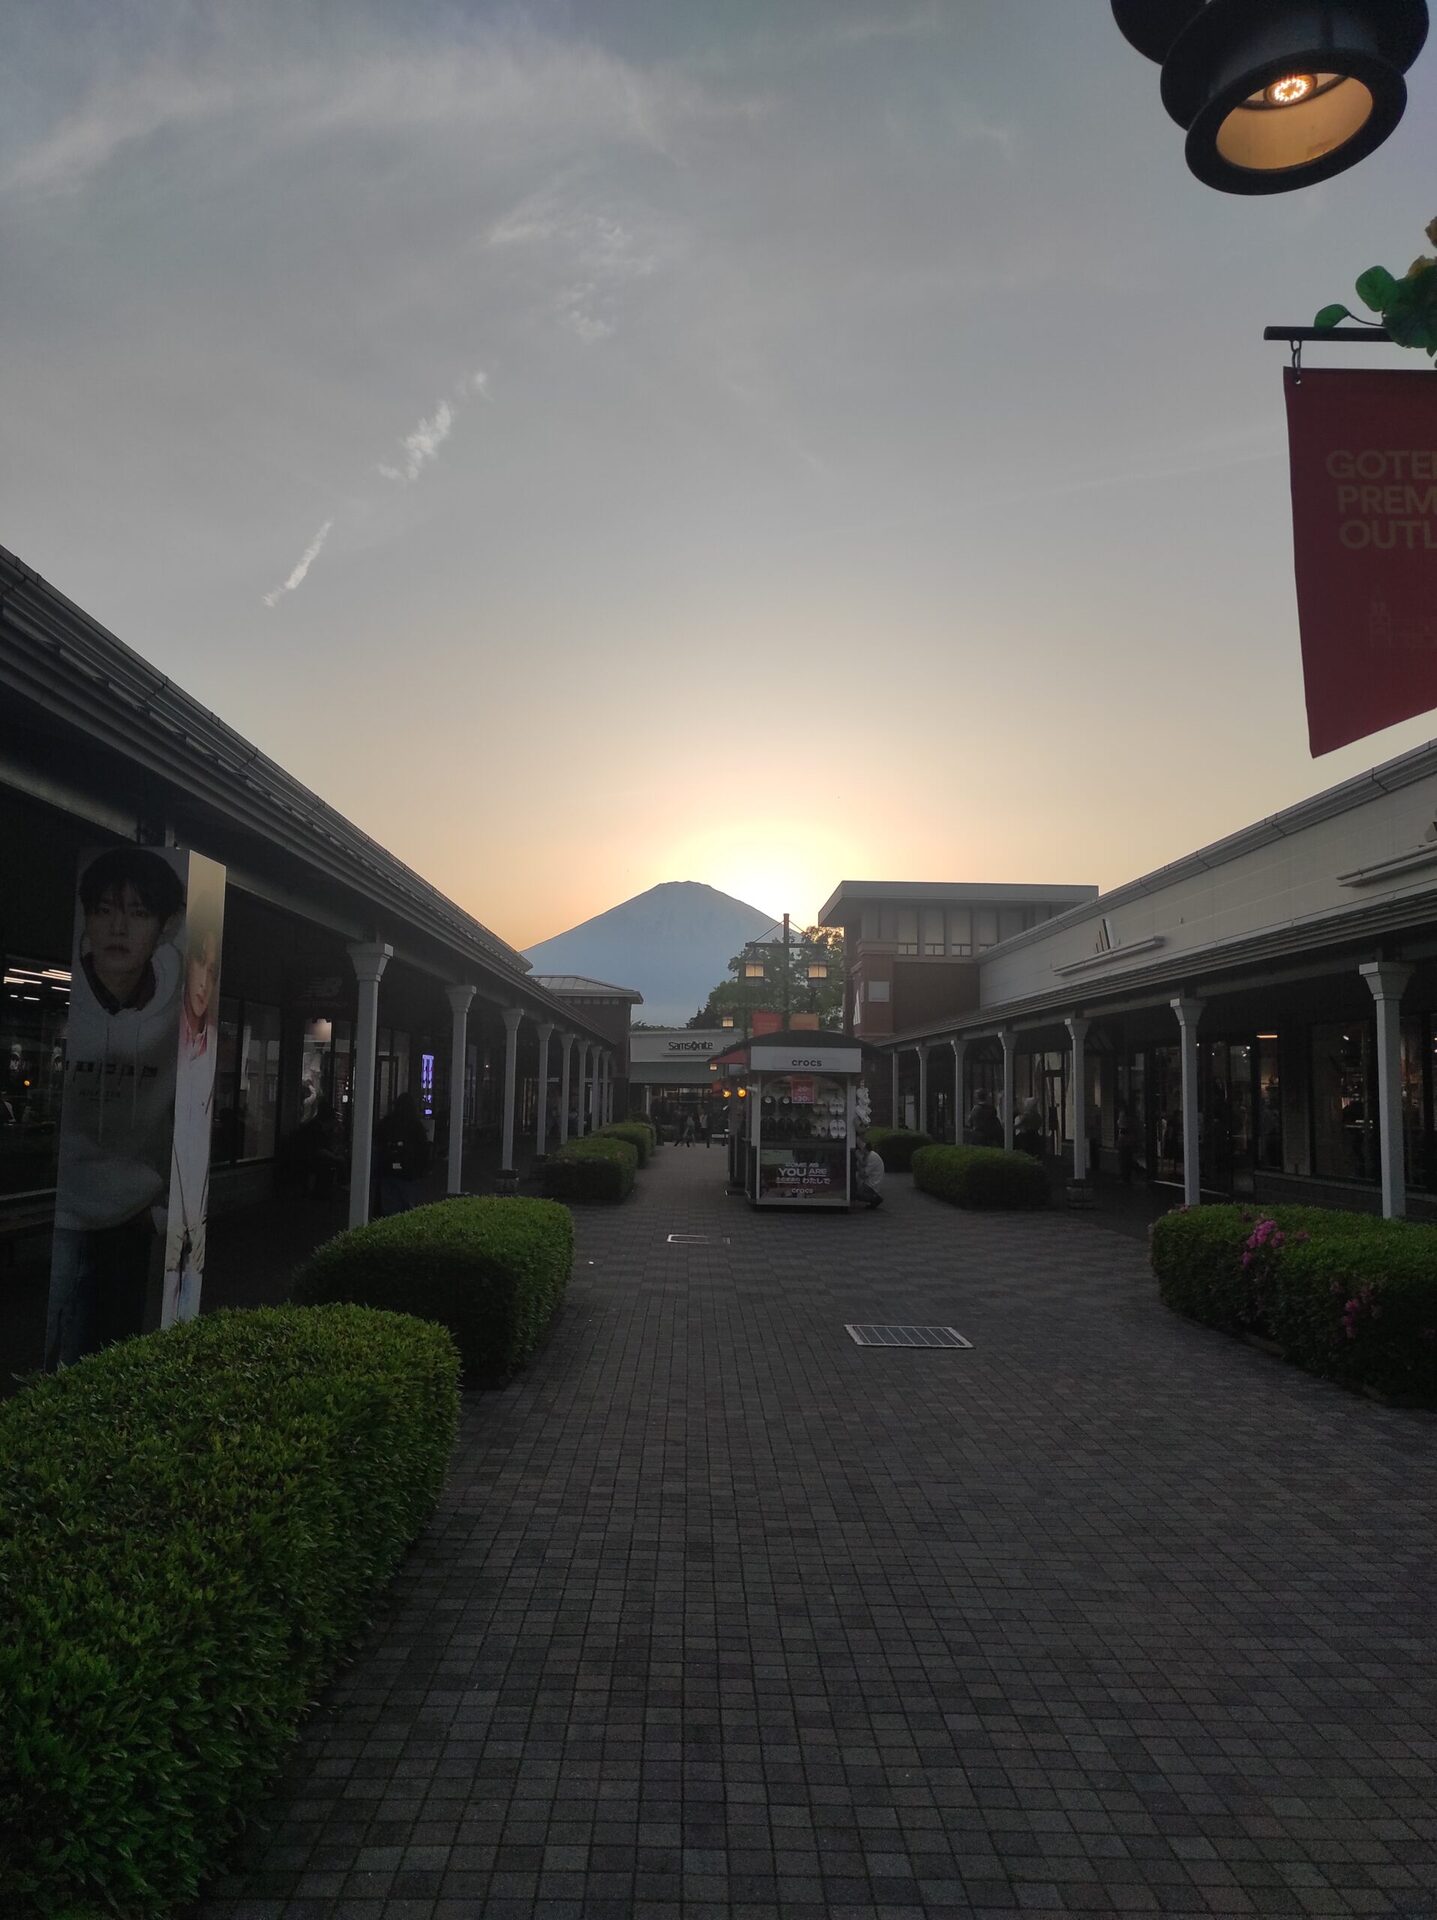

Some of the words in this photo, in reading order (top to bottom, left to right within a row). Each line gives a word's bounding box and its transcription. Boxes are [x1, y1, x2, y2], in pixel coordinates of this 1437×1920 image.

[1326, 450, 1437, 480] GOTE
[668, 1040, 713, 1051] Samsonite
[791, 1059, 822, 1067] crocs
[778, 1167, 807, 1177] YOU
[808, 1167, 828, 1175] ARE
